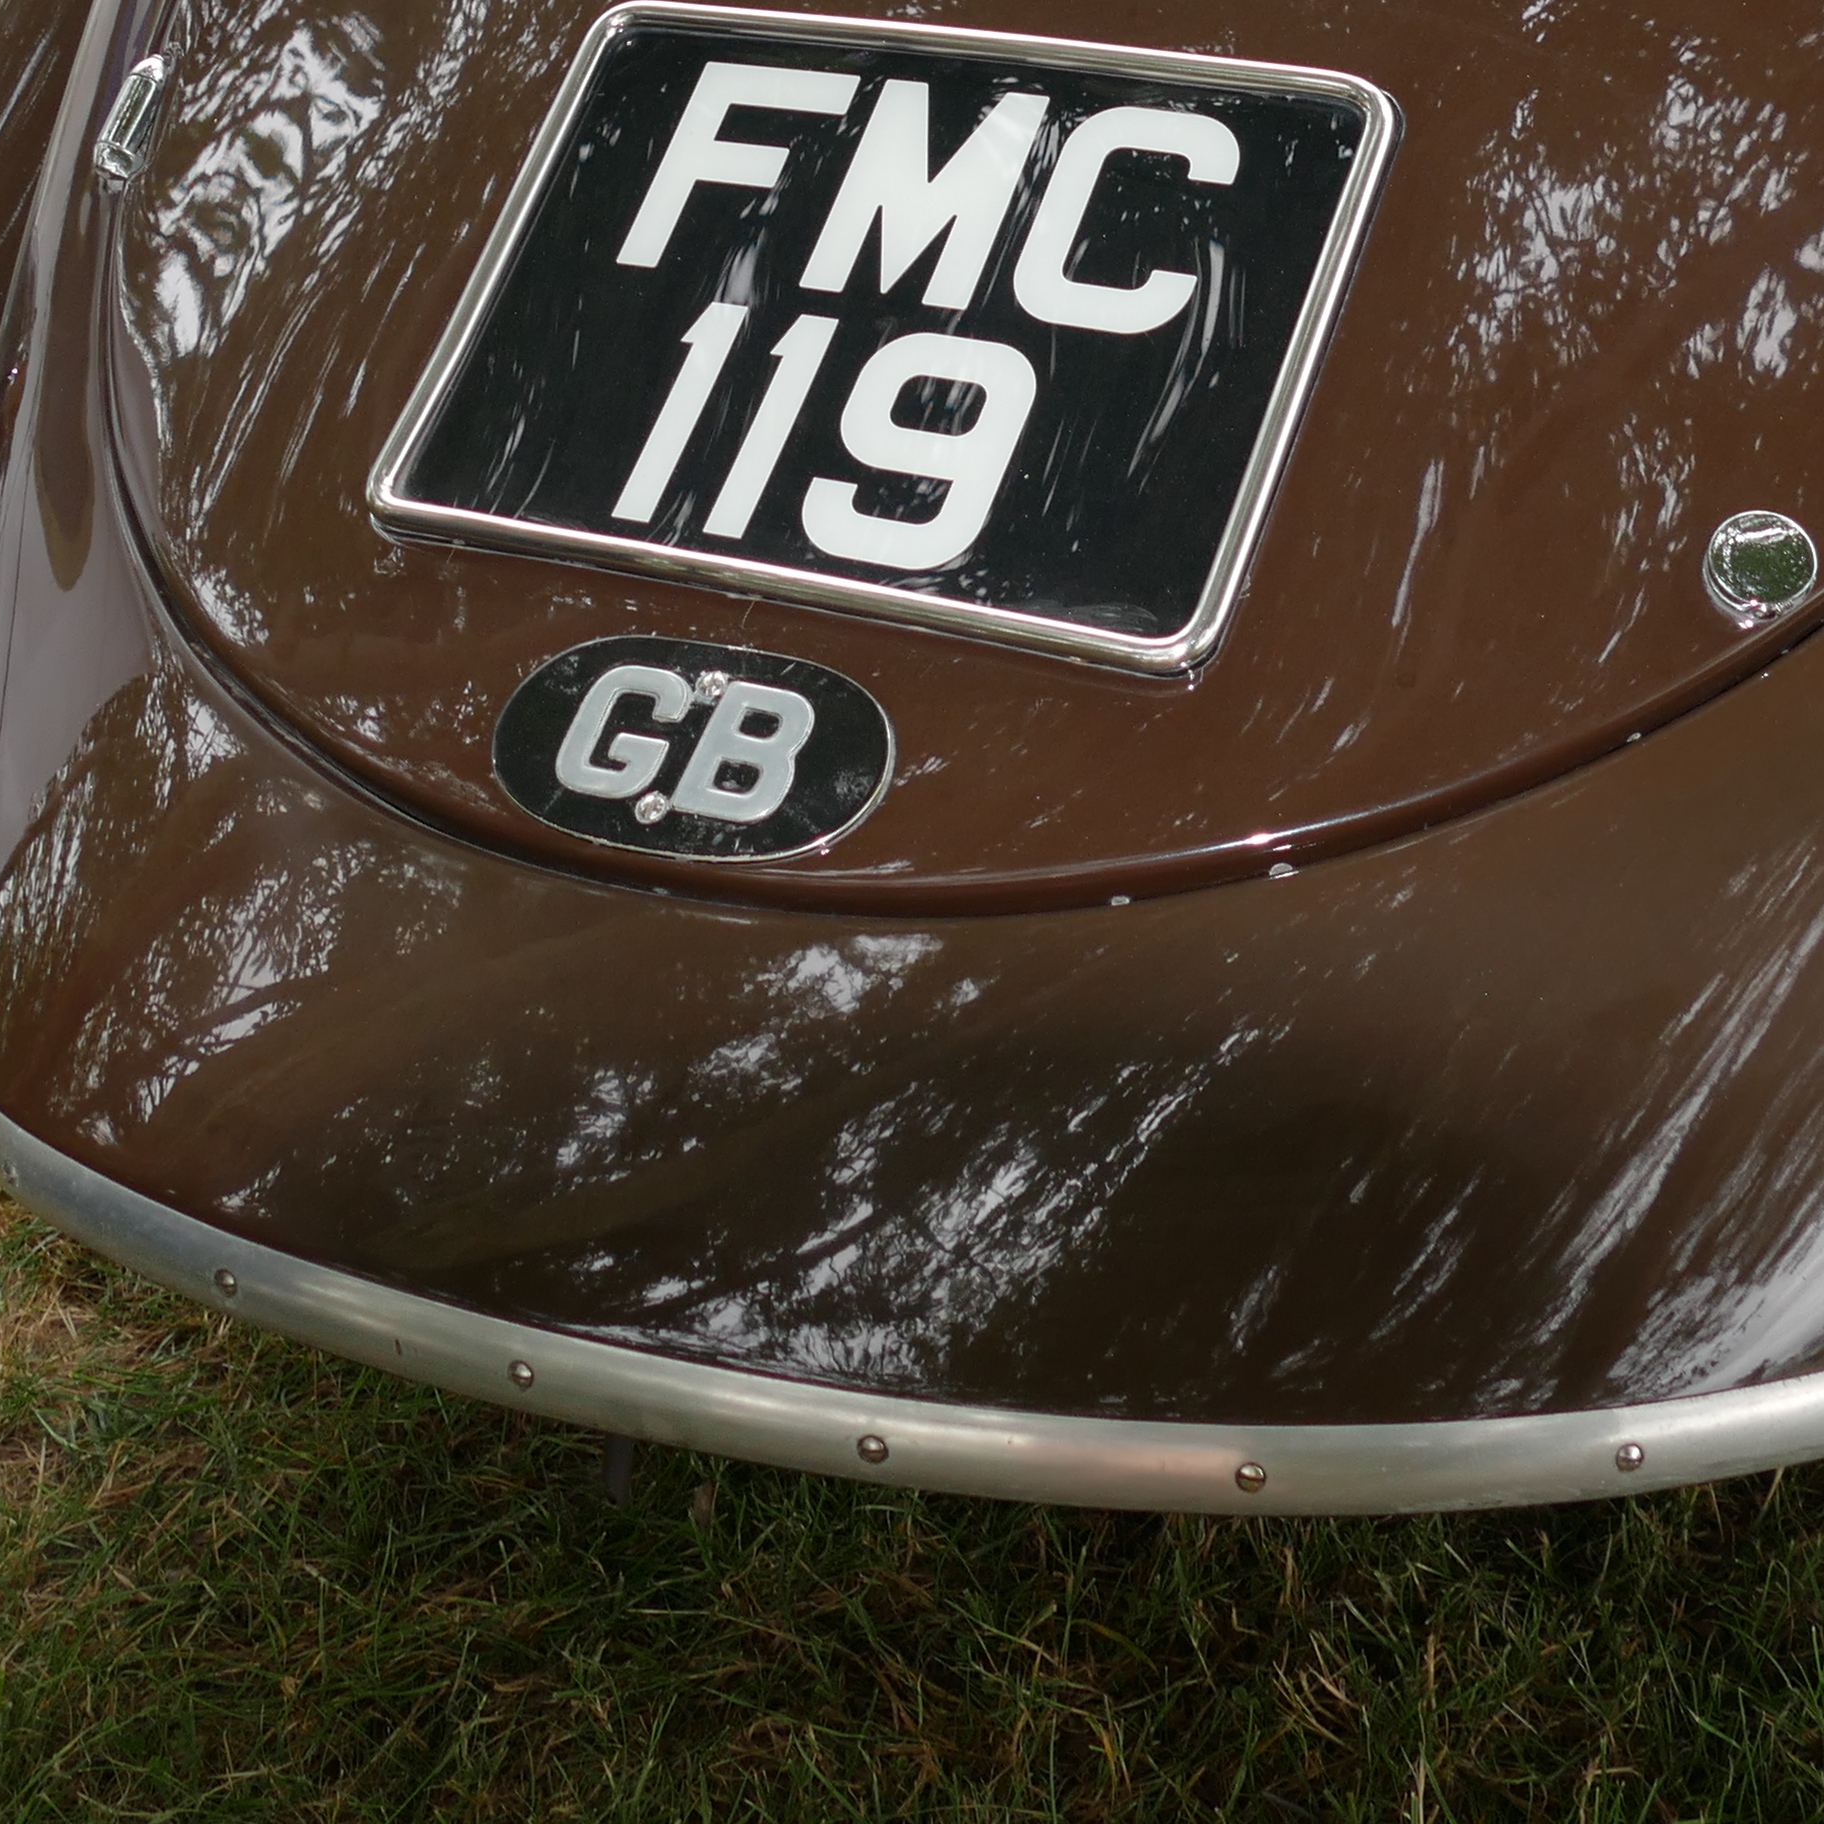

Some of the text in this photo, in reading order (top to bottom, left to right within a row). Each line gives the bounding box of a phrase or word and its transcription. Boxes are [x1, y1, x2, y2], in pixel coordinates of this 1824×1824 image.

[616, 61, 1241, 334] FMC
[612, 303, 1037, 572] 119
[555, 664, 815, 826] GB
